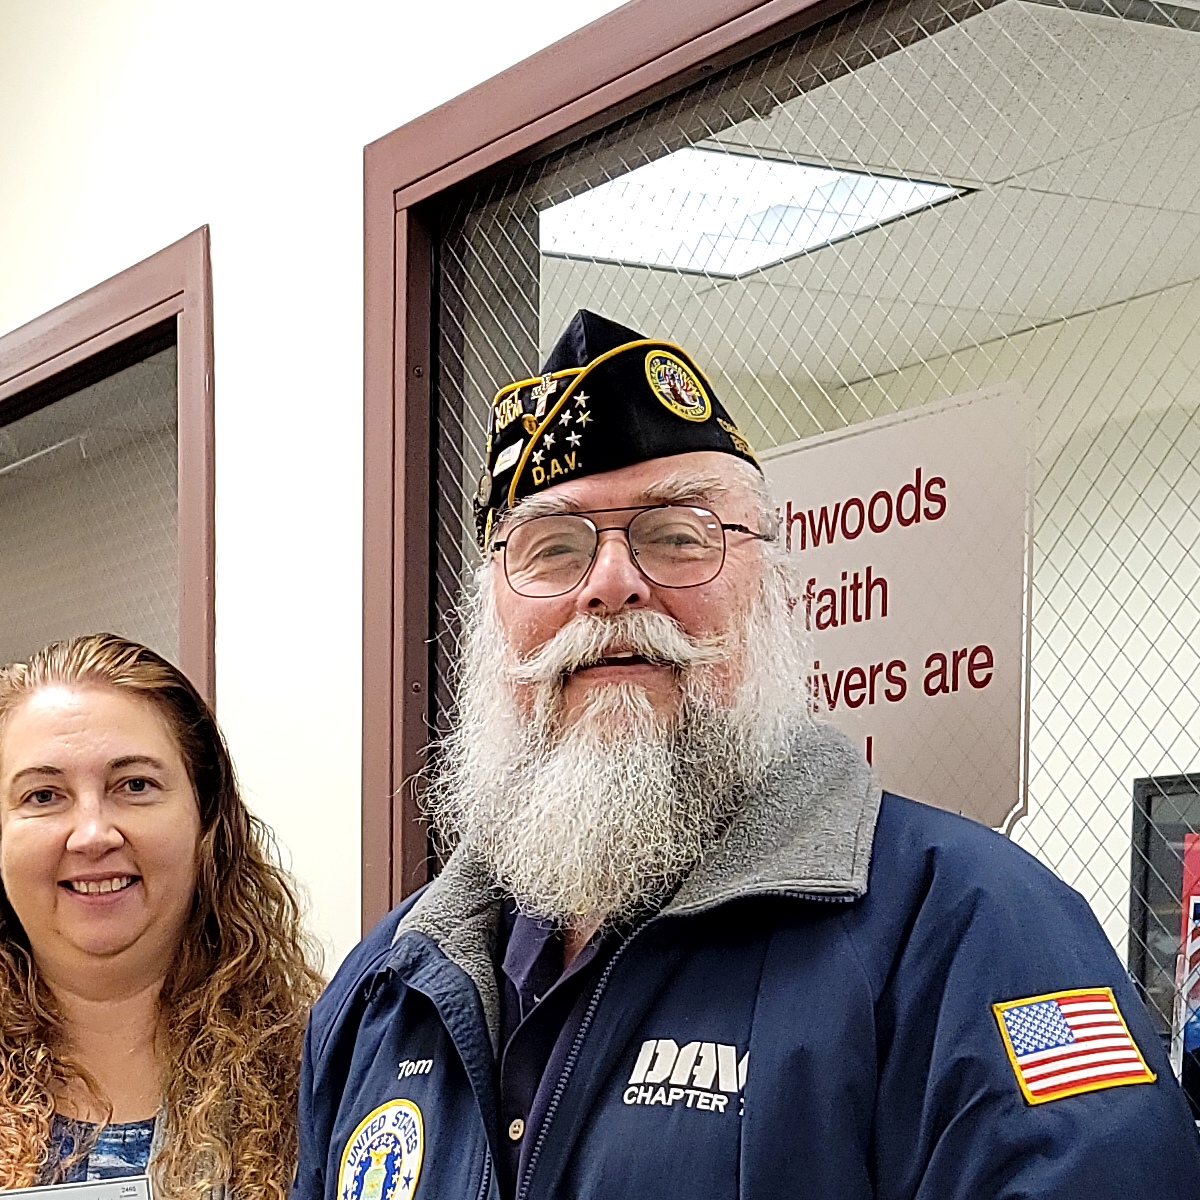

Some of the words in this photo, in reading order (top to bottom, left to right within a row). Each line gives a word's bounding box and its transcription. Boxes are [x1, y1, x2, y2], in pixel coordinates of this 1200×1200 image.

[496, 399, 523, 434] NAM
[532, 451, 582, 486] D.A.V.
[776, 467, 947, 554] hwoods
[788, 566, 889, 632] faith
[806, 659, 907, 713] ivers
[923, 645, 994, 696] are
[397, 1059, 433, 1080] Tom
[623, 1085, 729, 1113] CHAPTER
[347, 1114, 387, 1167] UNITED
[392, 1110, 418, 1155] STATES
